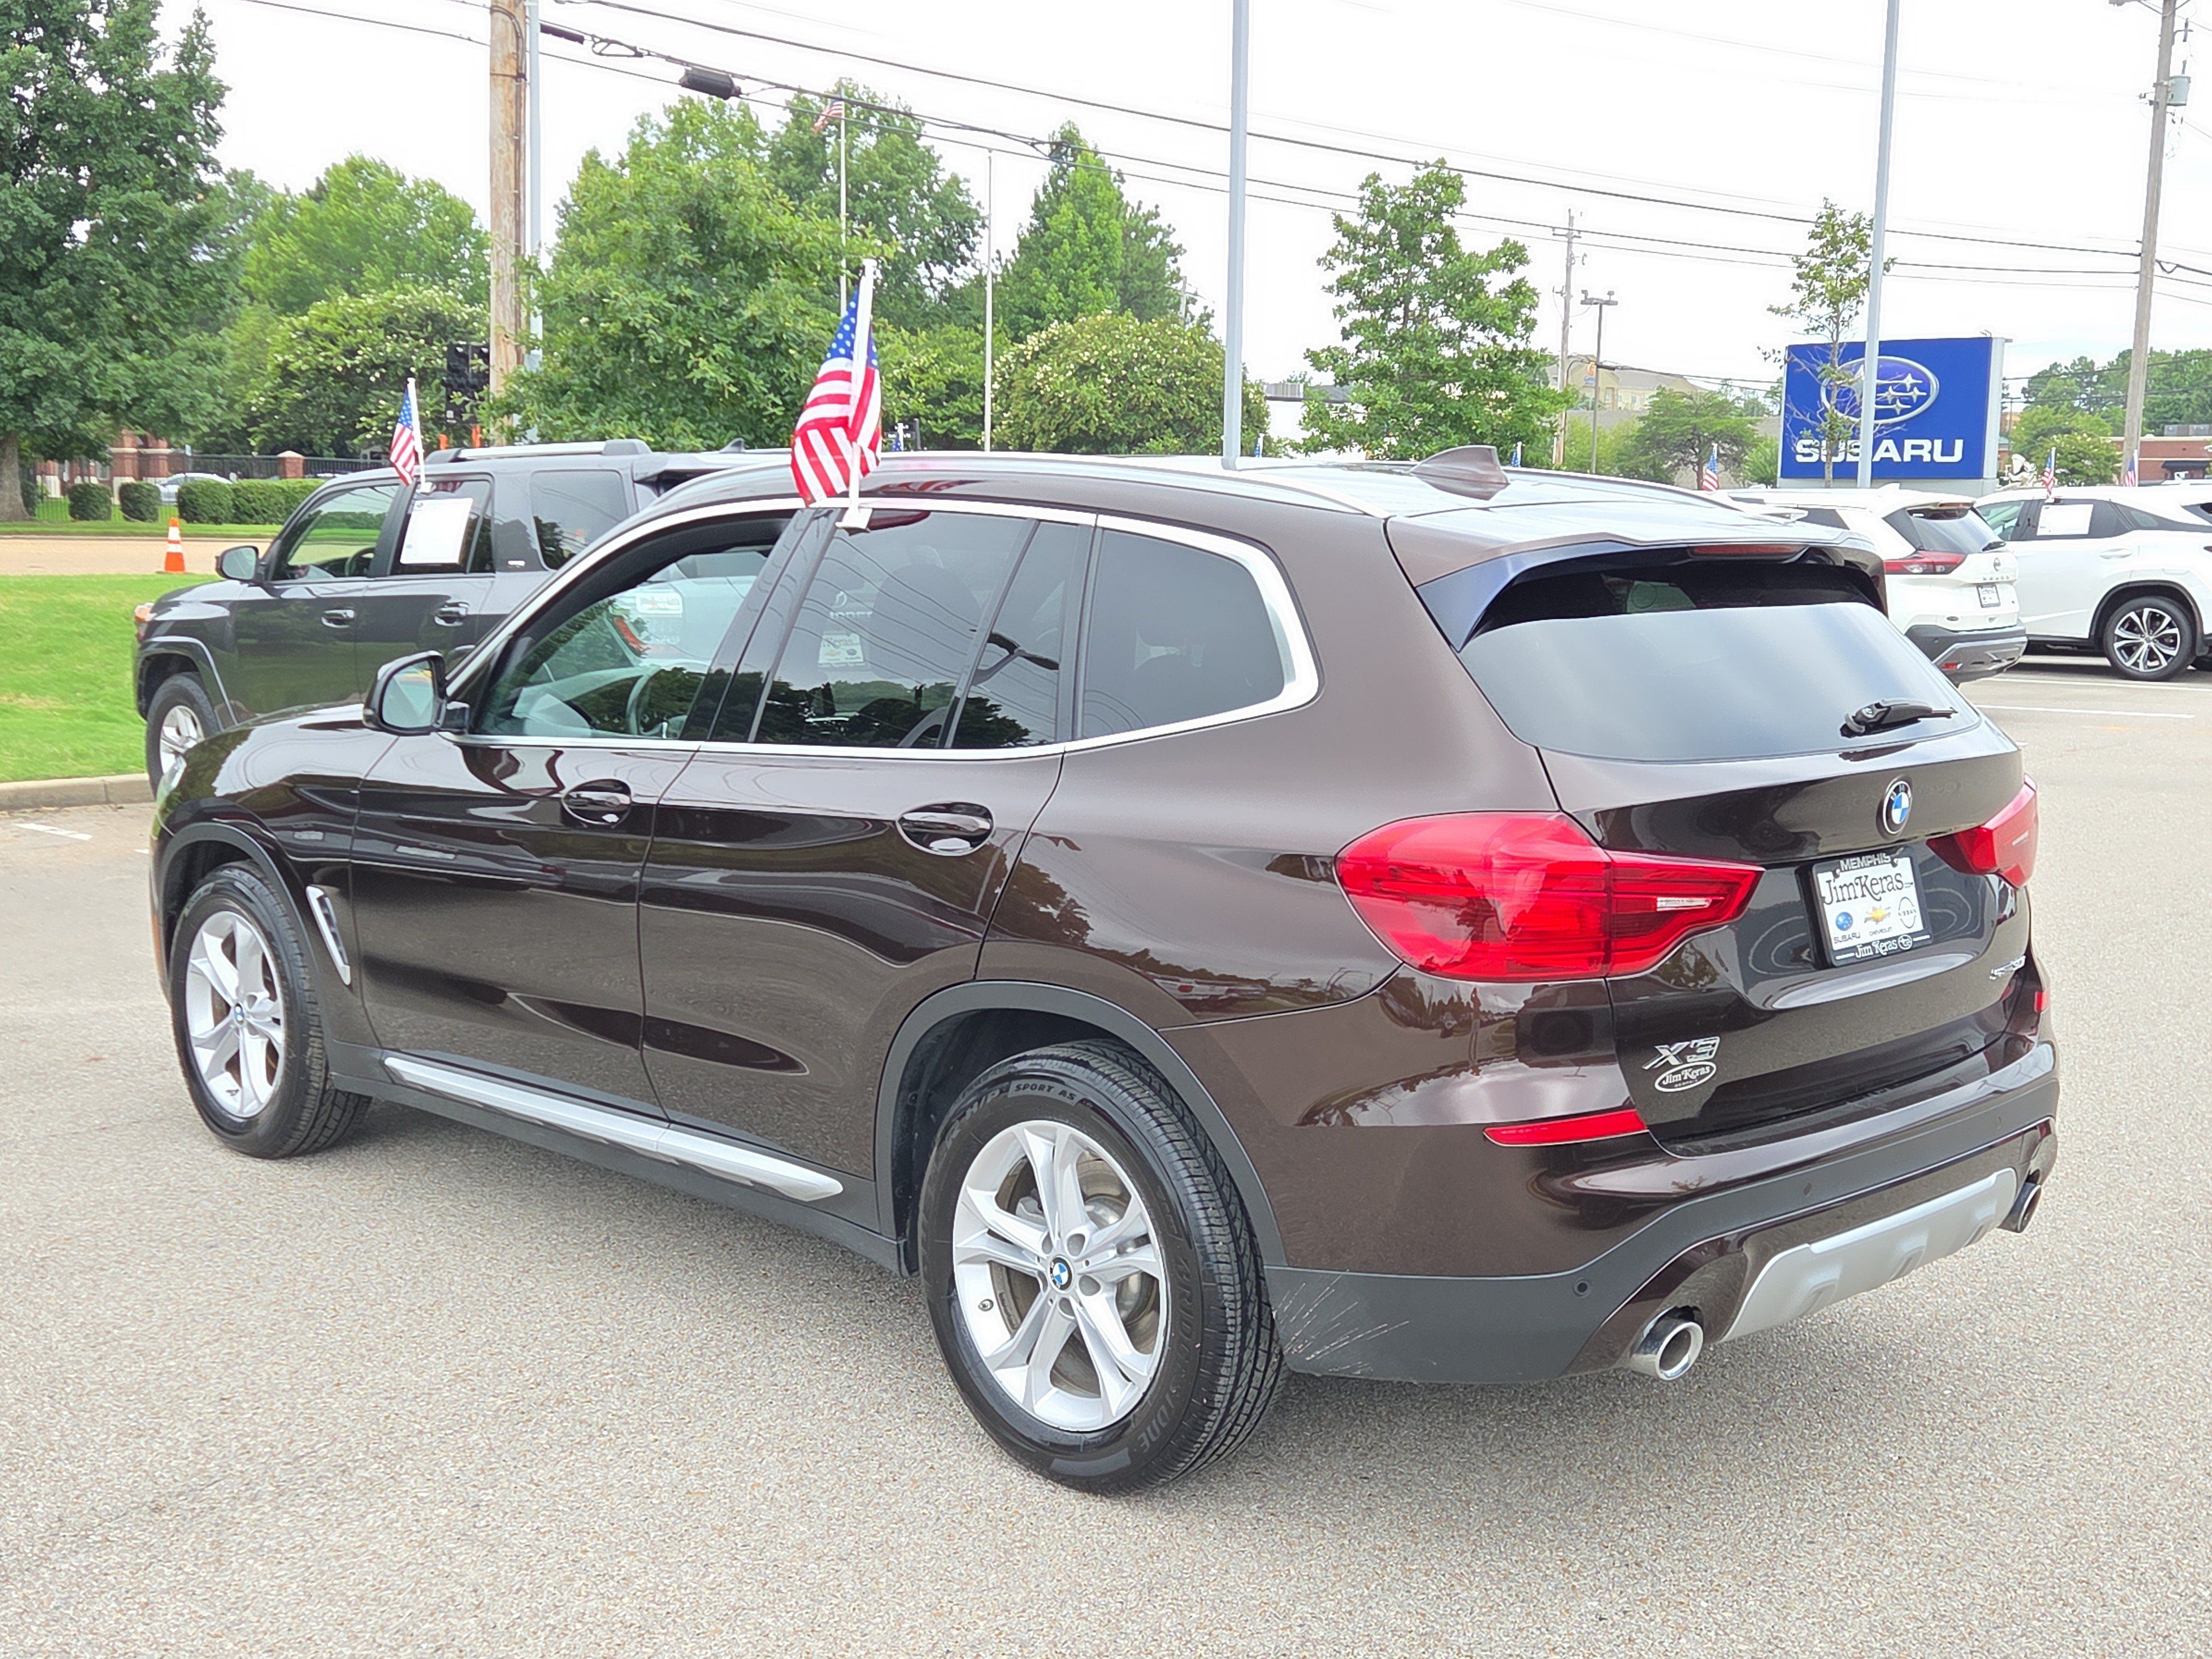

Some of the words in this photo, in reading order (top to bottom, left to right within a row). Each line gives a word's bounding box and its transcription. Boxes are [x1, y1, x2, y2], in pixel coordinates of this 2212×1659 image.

[1840, 853, 1891, 870] MEMPHIS
[1855, 944, 1873, 958] Jim
[1872, 940, 1899, 956] Keras
[1642, 1036, 1720, 1070] X3
[1662, 1073, 1682, 1085] Jim
[1681, 1066, 1710, 1079] Keras
[1015, 1083, 1055, 1092] SPORT
[1058, 1089, 1077, 1101] AS
